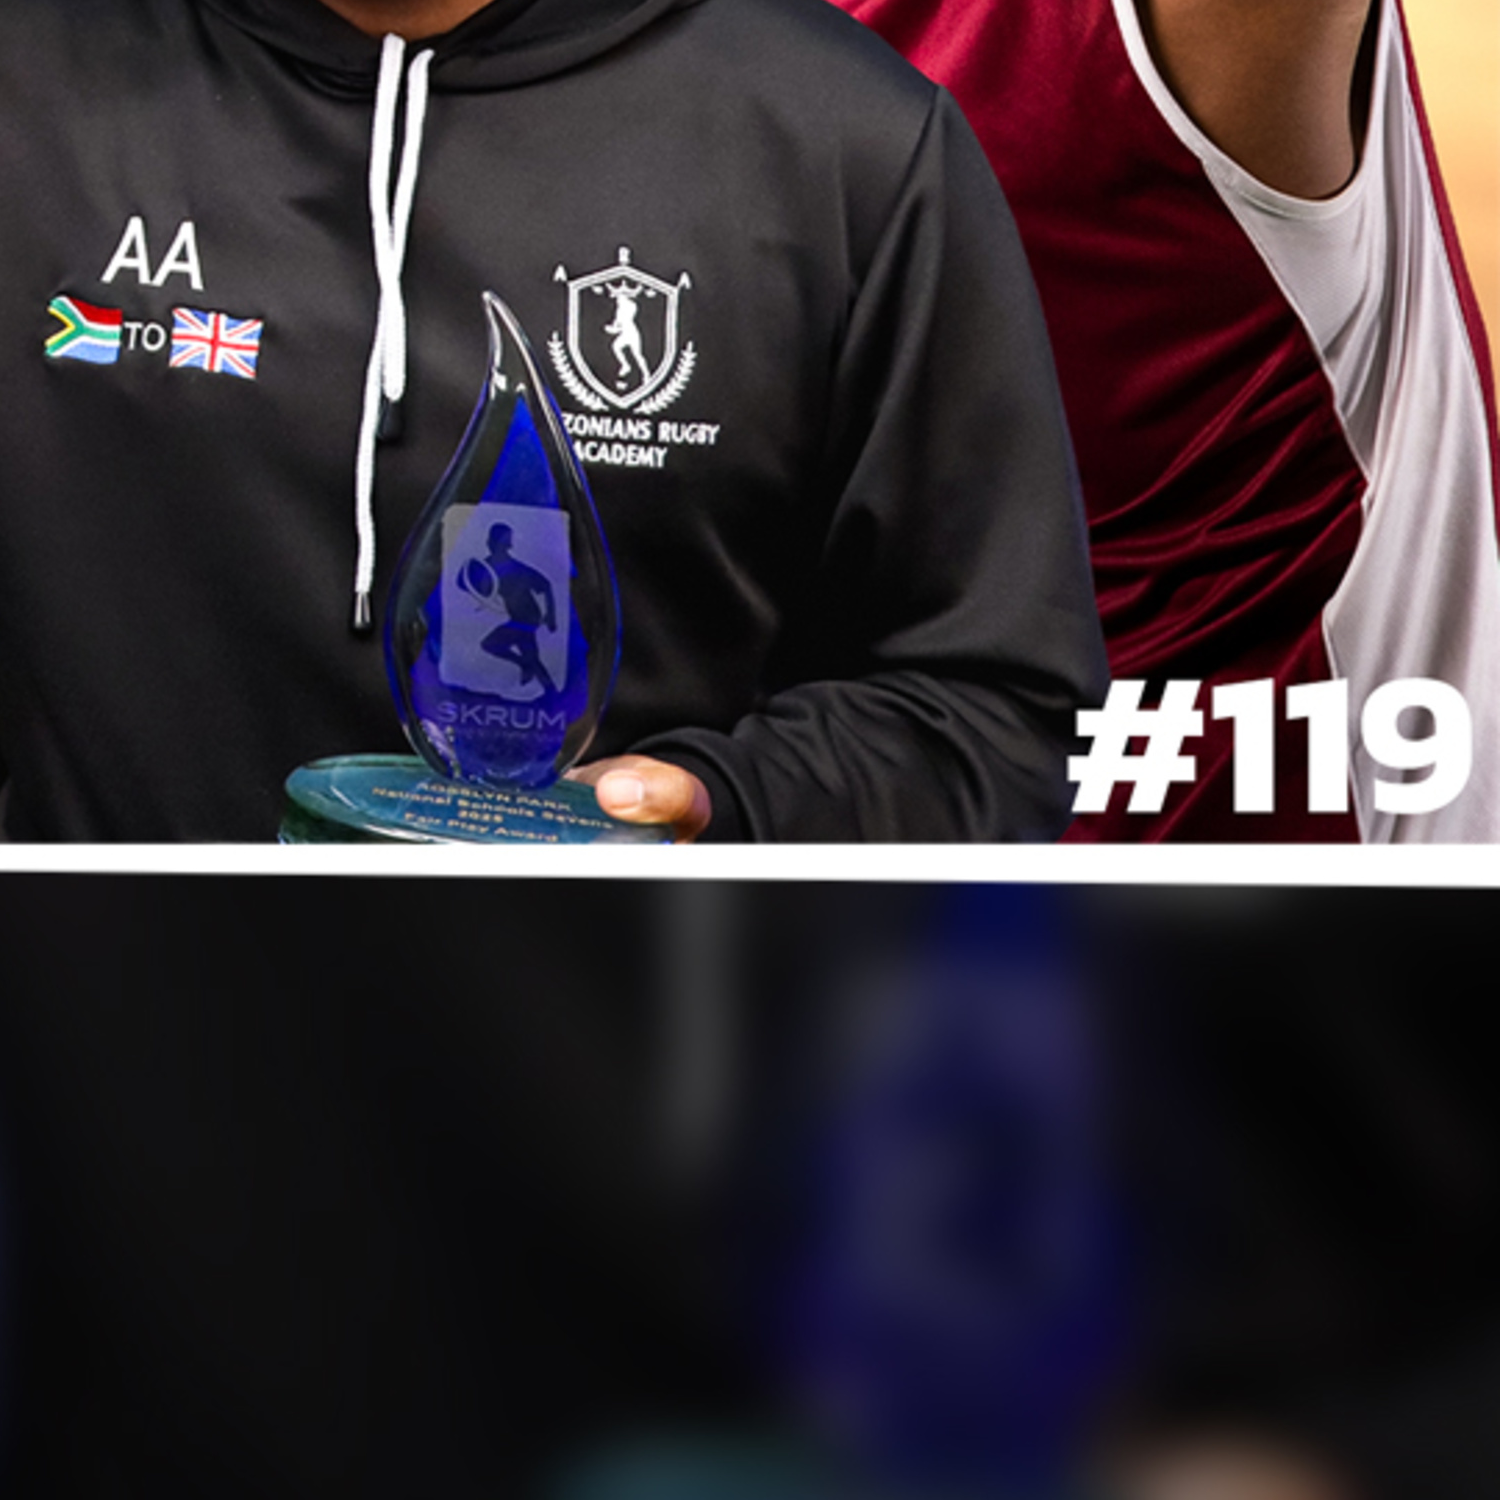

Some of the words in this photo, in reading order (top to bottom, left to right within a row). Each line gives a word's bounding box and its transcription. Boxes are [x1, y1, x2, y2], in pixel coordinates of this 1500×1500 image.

[101, 215, 204, 291] AA
[123, 321, 167, 352] TO
[658, 421, 720, 445] RUGBY
[437, 700, 566, 732] SKRUM
